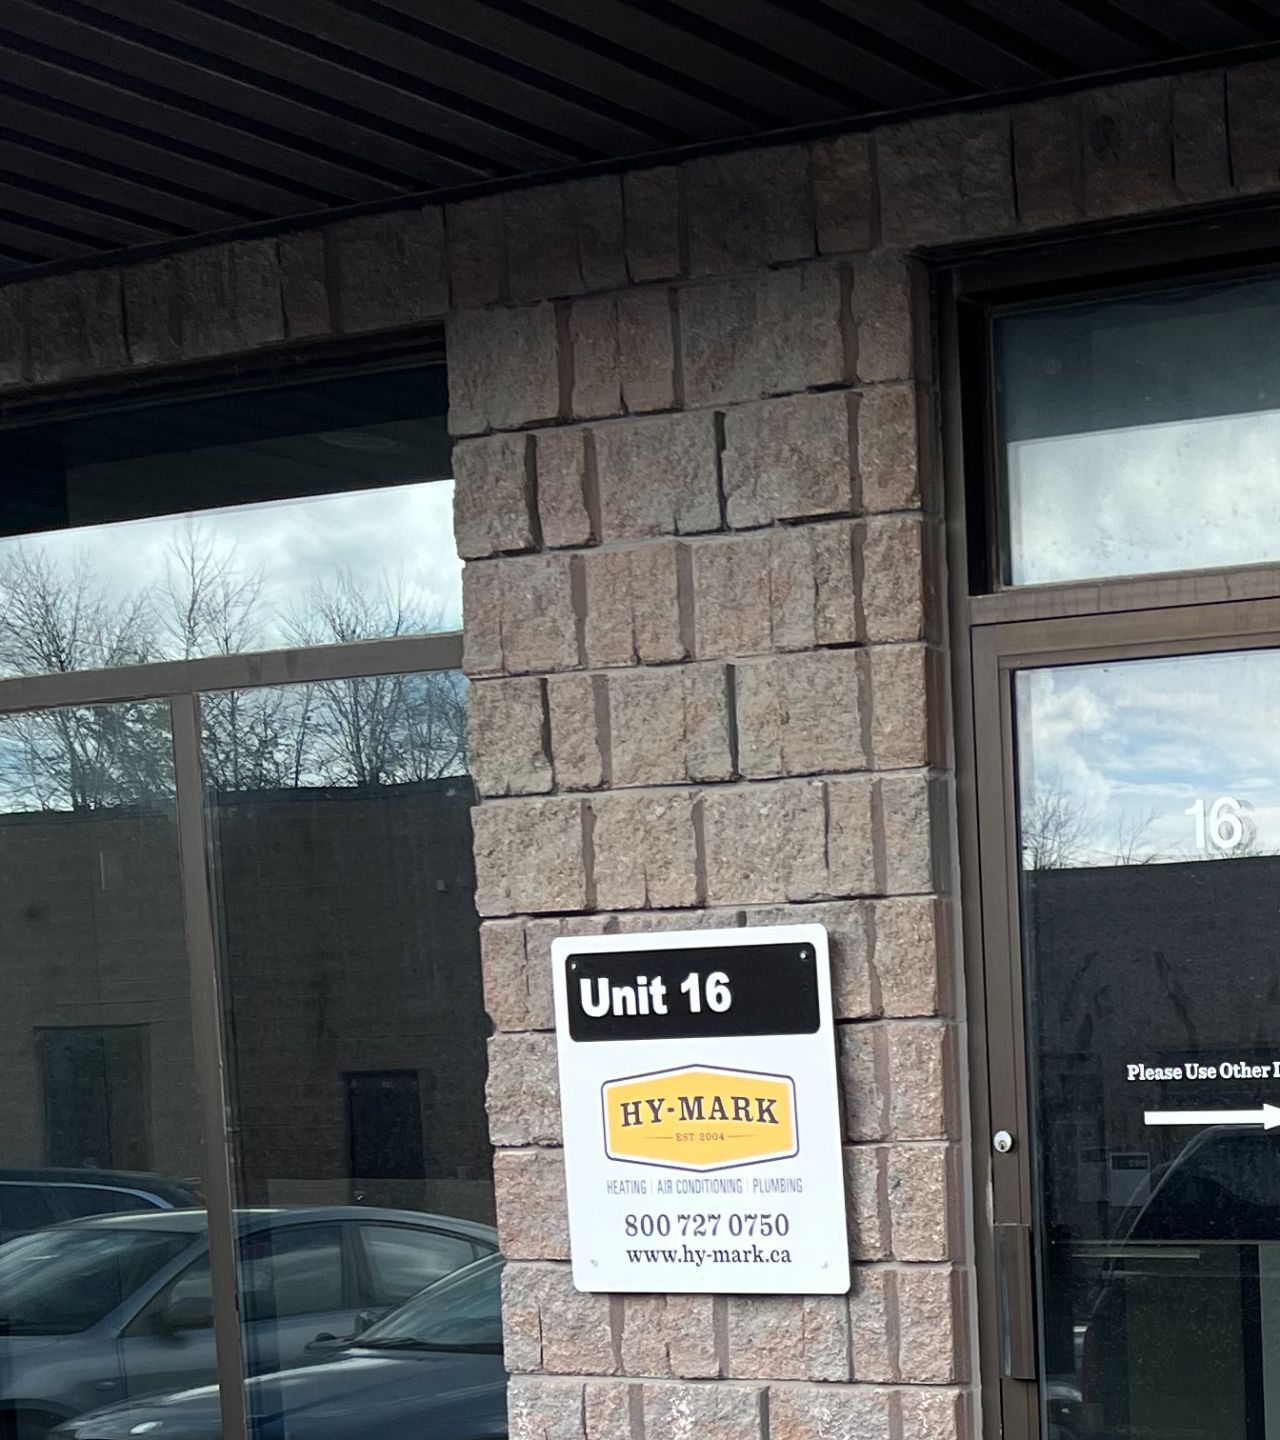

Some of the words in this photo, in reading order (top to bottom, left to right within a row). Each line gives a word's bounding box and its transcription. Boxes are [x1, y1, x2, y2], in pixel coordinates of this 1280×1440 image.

[1184, 796, 1244, 850] 16
[579, 974, 668, 1018] Unit
[680, 971, 732, 1014] 16
[1126, 1063, 1182, 1081] Please
[1184, 1062, 1217, 1080] Use
[1219, 1061, 1271, 1079] Other
[620, 1095, 780, 1128] HY-MARK
[699, 1131, 725, 1141] 2004
[606, 1180, 647, 1195] HEATING
[657, 1179, 673, 1194] AIR
[676, 1178, 743, 1194] CONDITIONING
[752, 1178, 803, 1194] PLUMBING
[625, 1213, 671, 1237] 800
[677, 1213, 721, 1237] 727
[728, 1213, 790, 1237] 0750
[626, 1244, 792, 1267] www.hy-mark.ca
